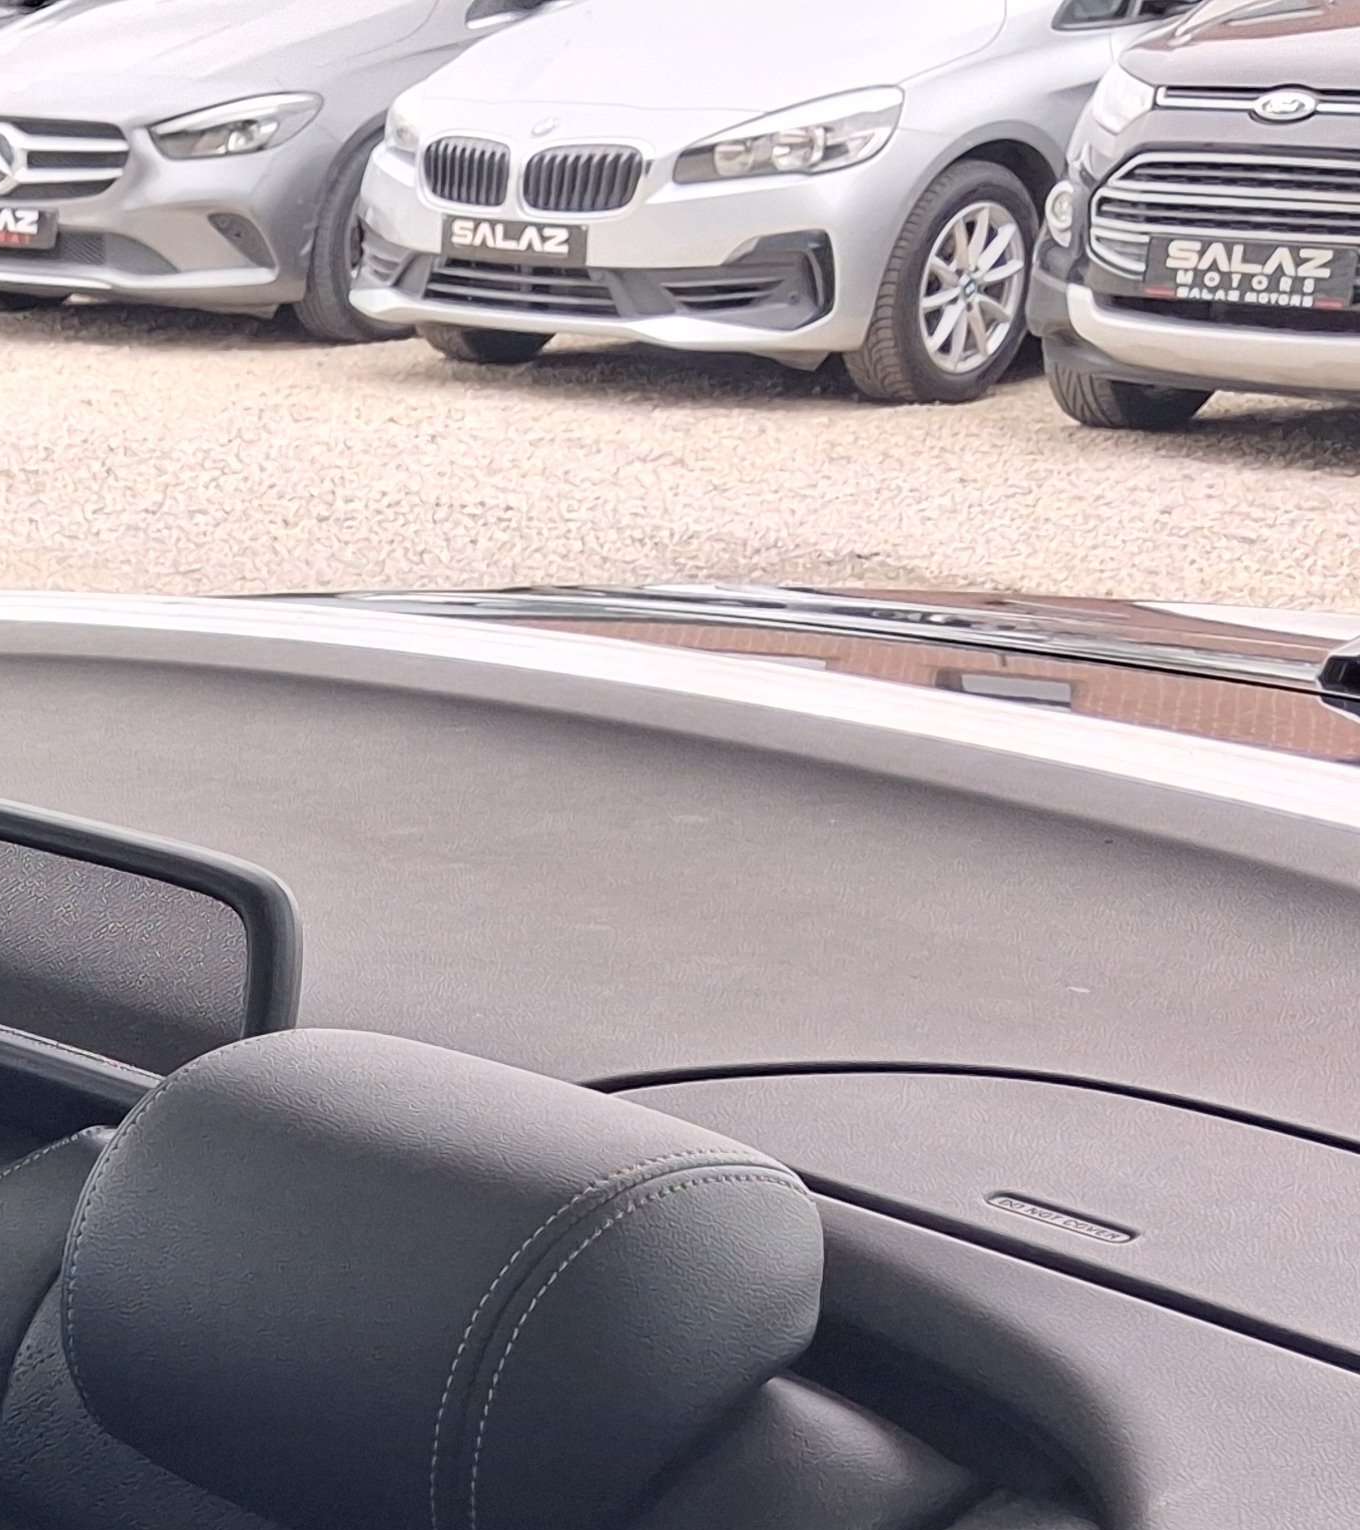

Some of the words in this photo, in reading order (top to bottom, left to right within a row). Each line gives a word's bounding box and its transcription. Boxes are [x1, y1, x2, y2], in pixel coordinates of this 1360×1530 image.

[451, 218, 569, 254] SALAZ
[1166, 240, 1334, 278] SALAZ
[1176, 270, 1315, 293] MOTORS
[998, 1199, 1025, 1210] DO
[1025, 1207, 1062, 1221] NOT
[1063, 1219, 1121, 1239] COVER
